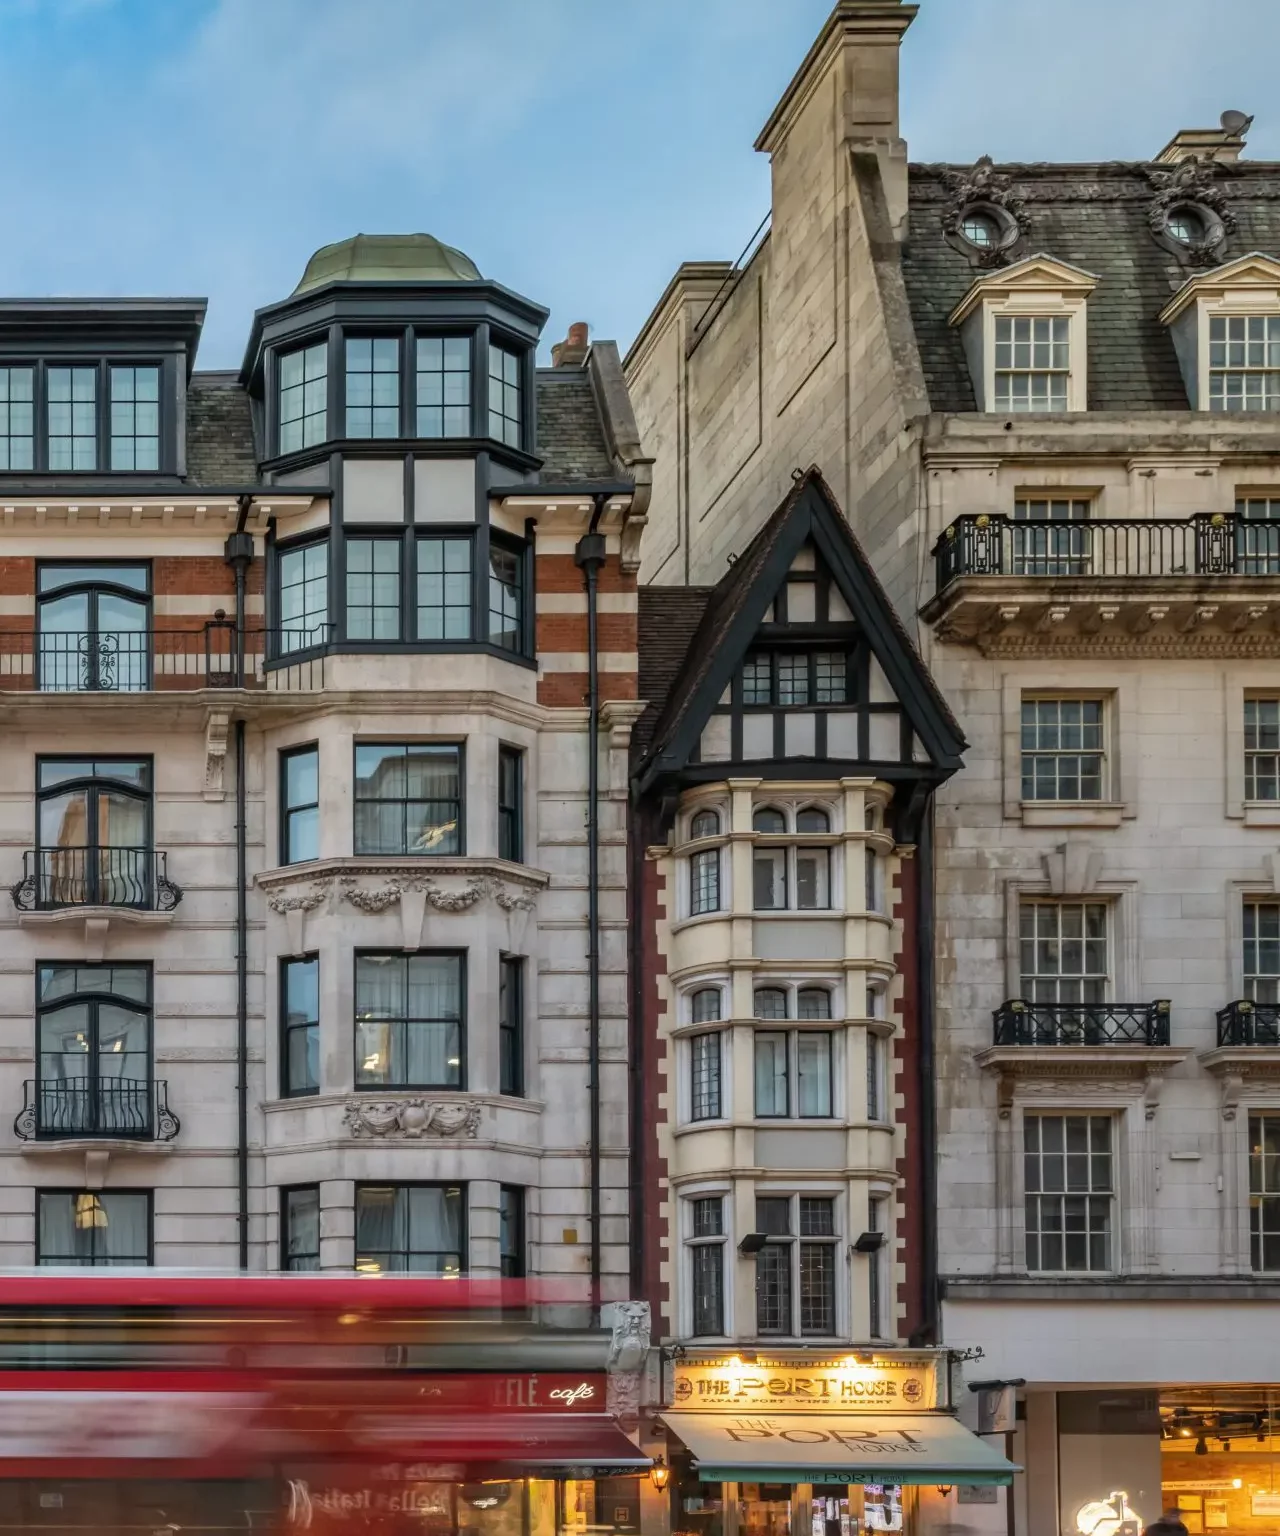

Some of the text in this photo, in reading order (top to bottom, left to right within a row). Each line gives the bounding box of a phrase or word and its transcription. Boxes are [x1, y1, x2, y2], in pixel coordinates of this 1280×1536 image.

[696, 1377, 897, 1397] THE PORT HOUSE
[549, 1382, 595, 1406] café
[730, 1419, 782, 1430] THE
[724, 1428, 922, 1444] PORT
[844, 1443, 928, 1453] HOUSE
[824, 1472, 875, 1483] PORT
